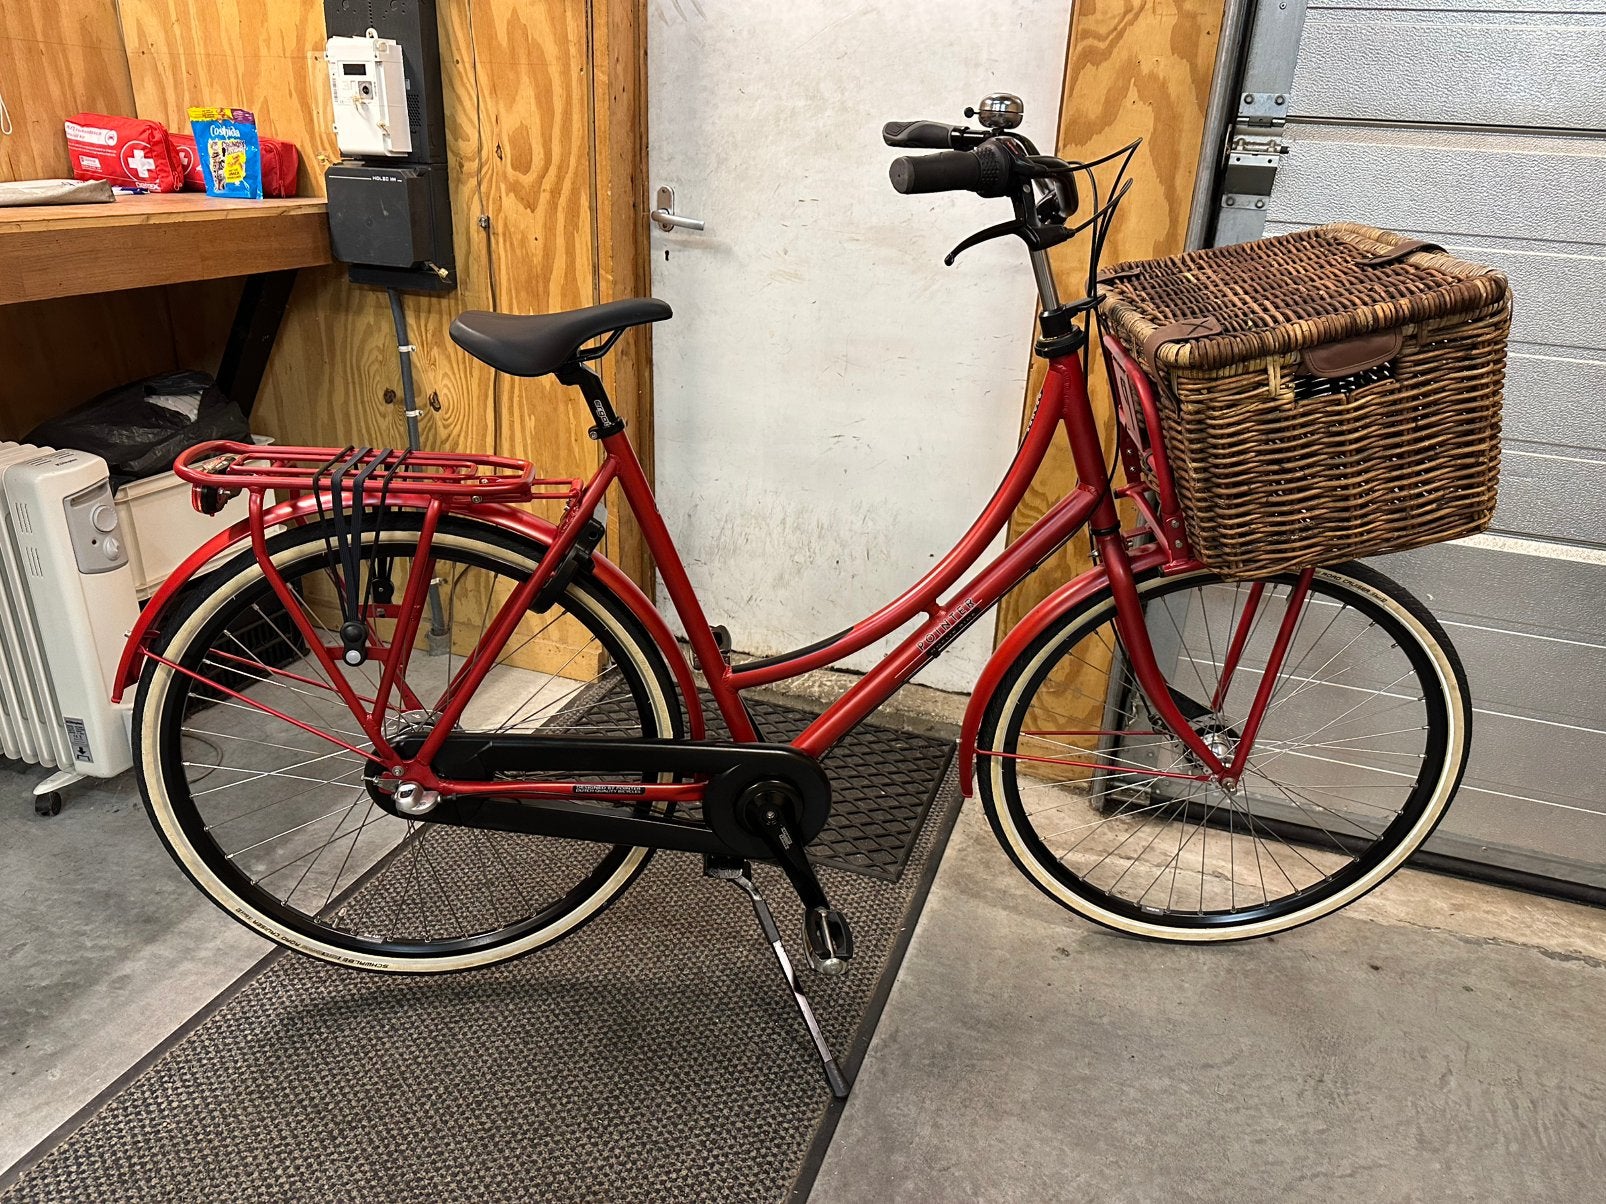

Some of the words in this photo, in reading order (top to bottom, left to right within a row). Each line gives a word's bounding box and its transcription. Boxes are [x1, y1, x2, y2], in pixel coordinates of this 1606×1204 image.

[916, 597, 975, 651] POINTER
[252, 920, 281, 939] CRUISER
[343, 957, 389, 969] SCHWALBE
